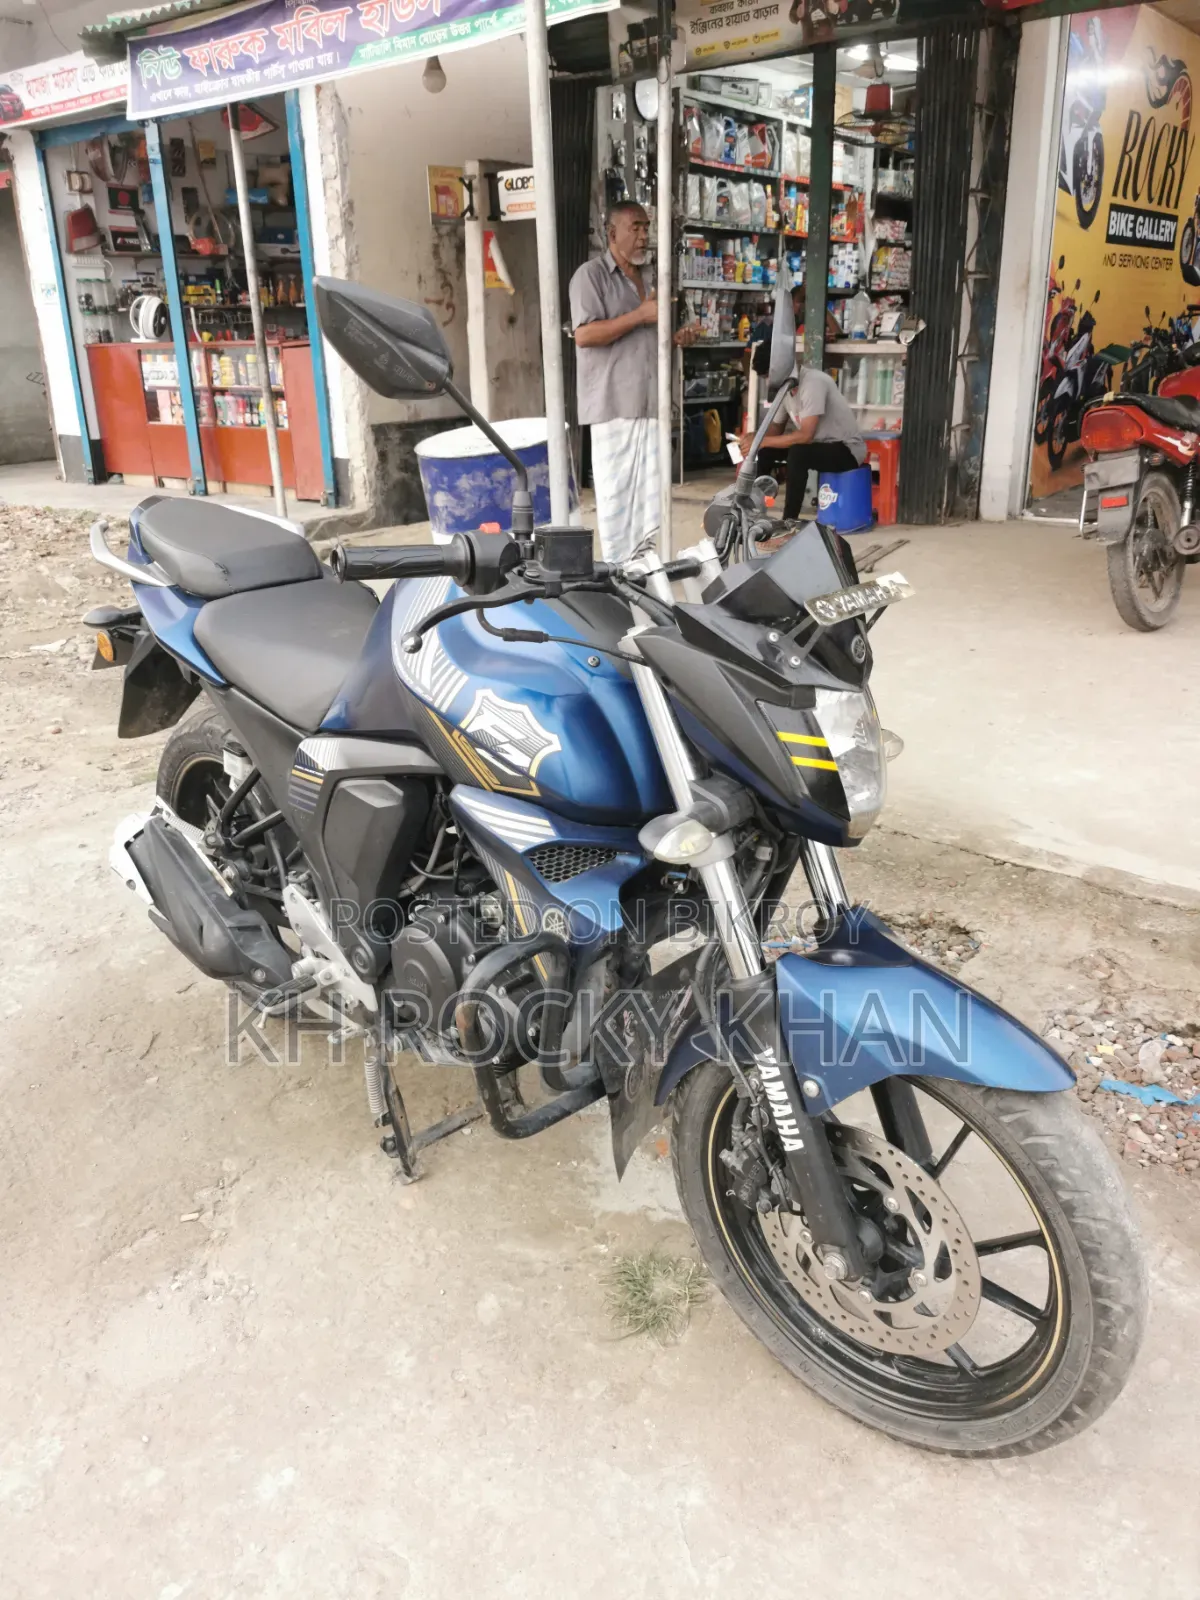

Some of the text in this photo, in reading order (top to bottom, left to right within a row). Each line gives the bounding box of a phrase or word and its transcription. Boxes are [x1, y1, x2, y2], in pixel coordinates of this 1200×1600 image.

[136, 44, 182, 90] নিউ
[183, 28, 269, 77] ফারুক
[271, 5, 353, 56] মবিল
[690, 3, 780, 35] ইঞ্জিনের হায়াত বাড়ান
[1111, 109, 1195, 209] ROCKY
[1108, 211, 1177, 243] BIKE GALLERY
[834, 580, 903, 612] YAMAHA
[754, 1047, 805, 1152] YAMAHA
